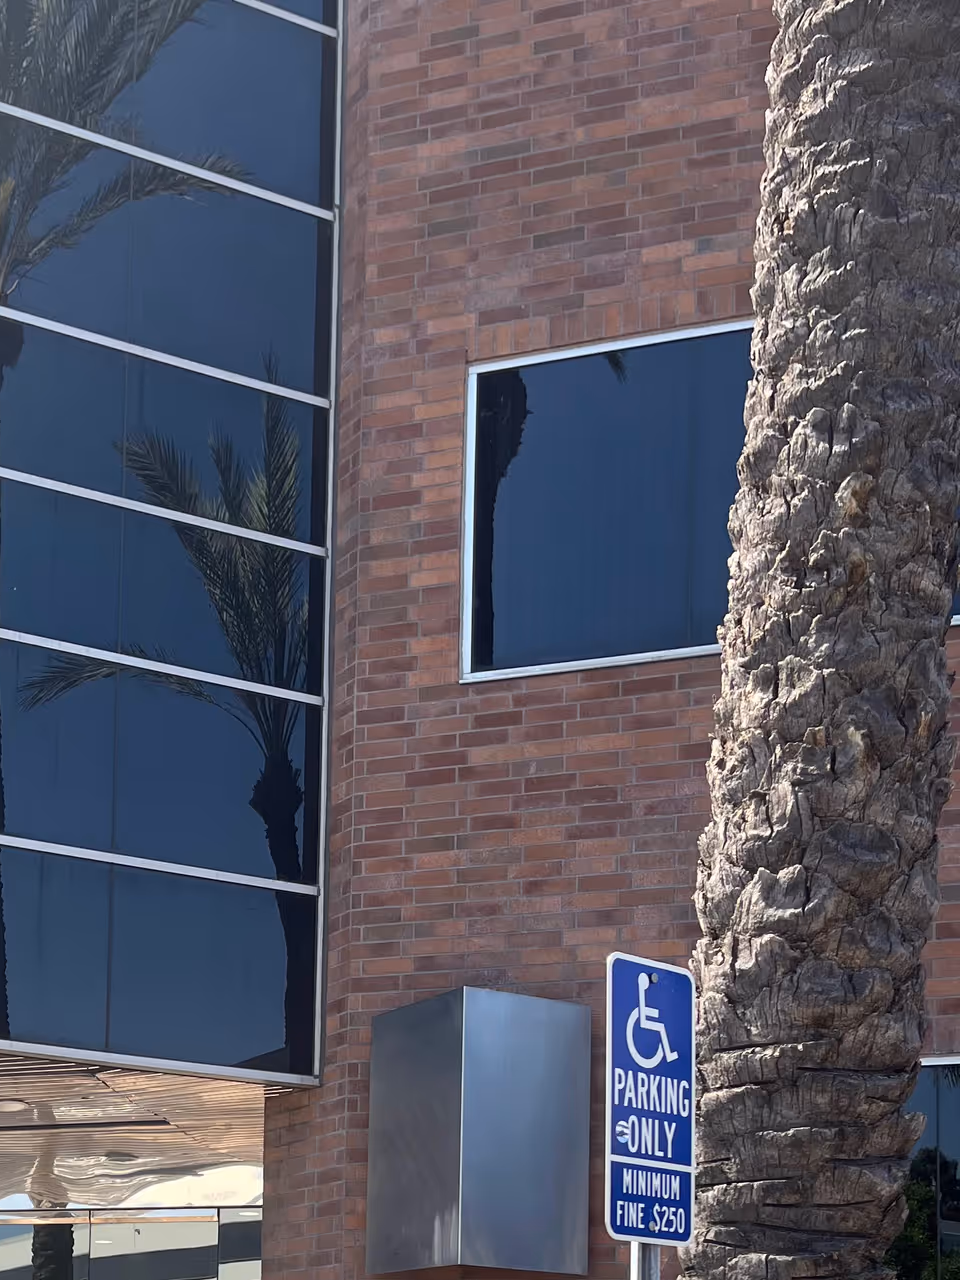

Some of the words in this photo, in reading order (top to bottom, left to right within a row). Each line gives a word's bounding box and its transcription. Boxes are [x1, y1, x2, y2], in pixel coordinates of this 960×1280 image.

[614, 1067, 690, 1118] PARKING
[627, 1114, 677, 1159] ONLY
[622, 1168, 681, 1201] MINIMUM
[616, 1200, 645, 1229] FINE
[652, 1202, 686, 1234] $250
